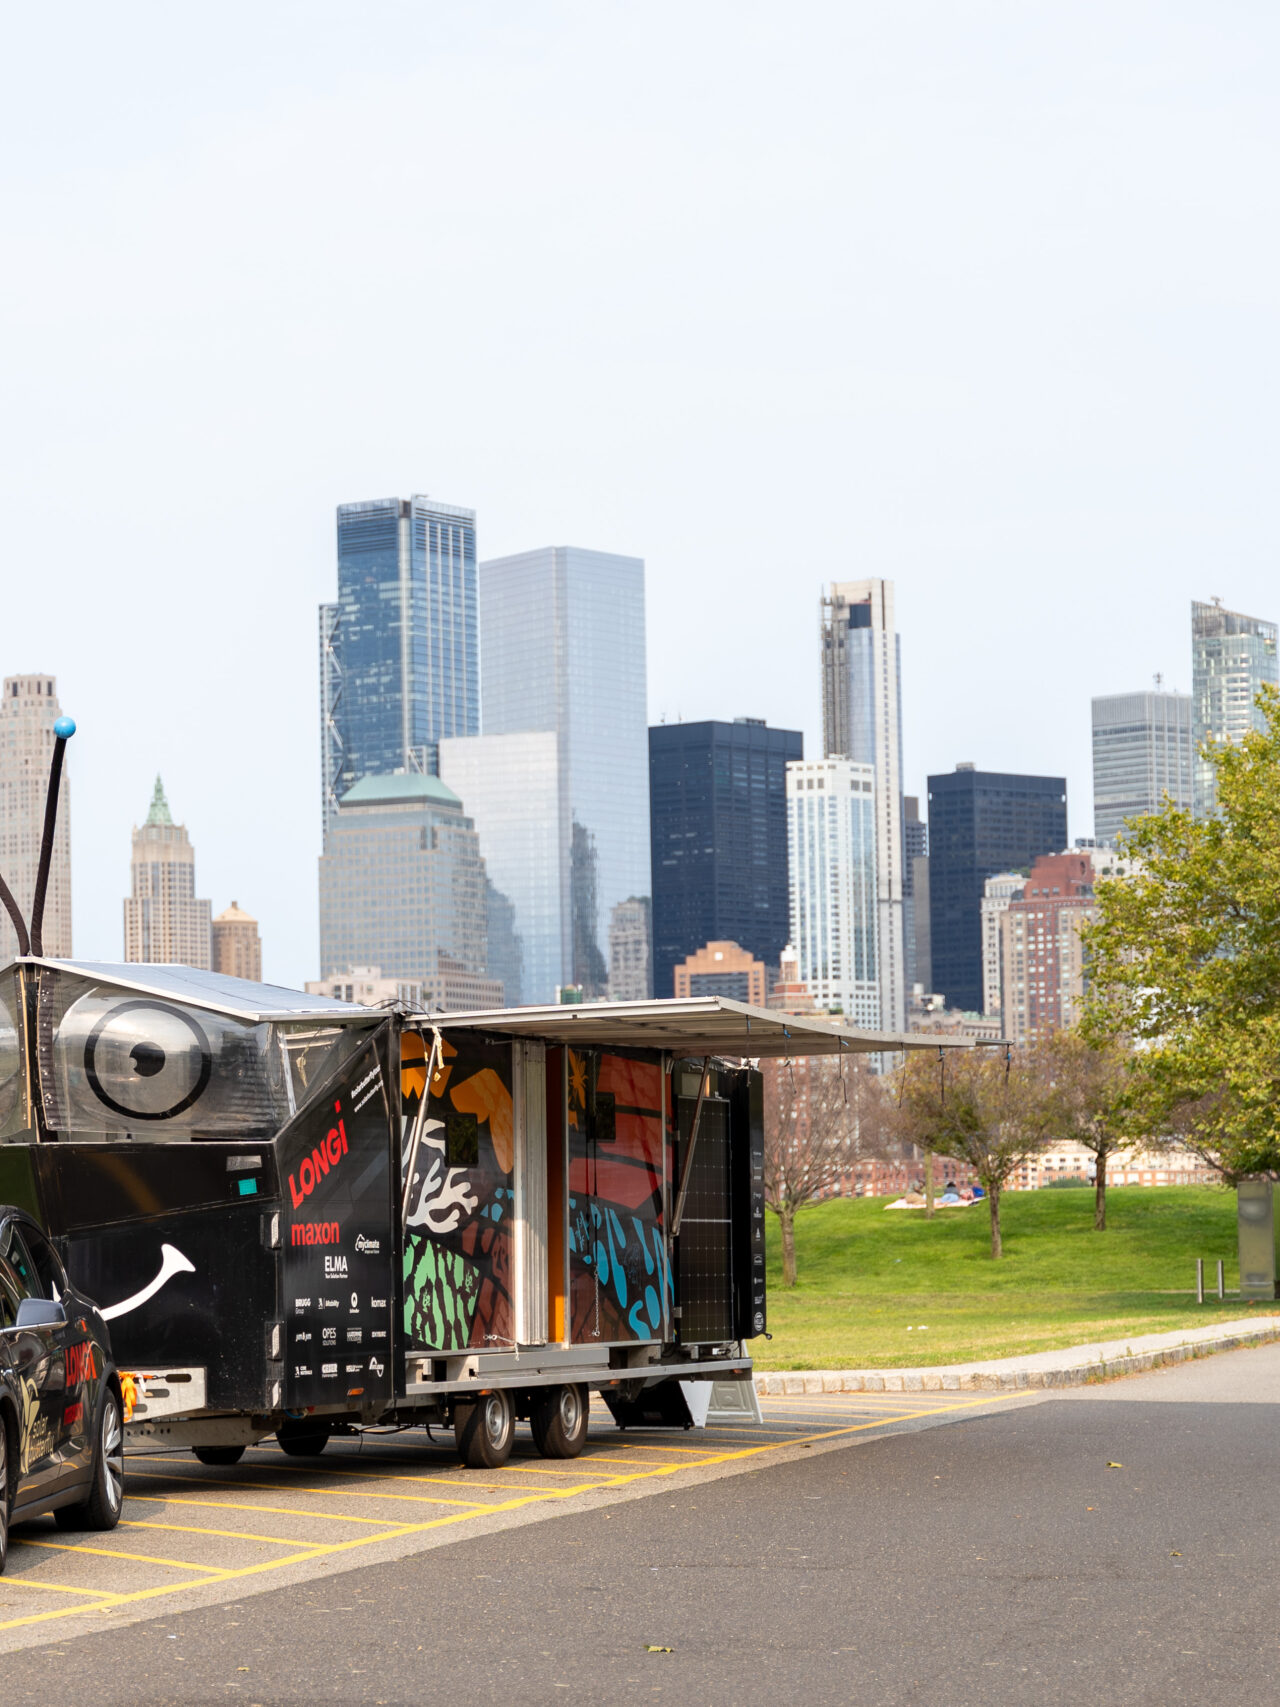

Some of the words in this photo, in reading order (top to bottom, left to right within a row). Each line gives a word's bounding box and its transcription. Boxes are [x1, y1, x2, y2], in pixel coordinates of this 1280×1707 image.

[291, 1221, 340, 1246] maxon
[324, 1255, 348, 1272] ELMA
[322, 1327, 337, 1339] OPES
[32, 1412, 49, 1439] solar
